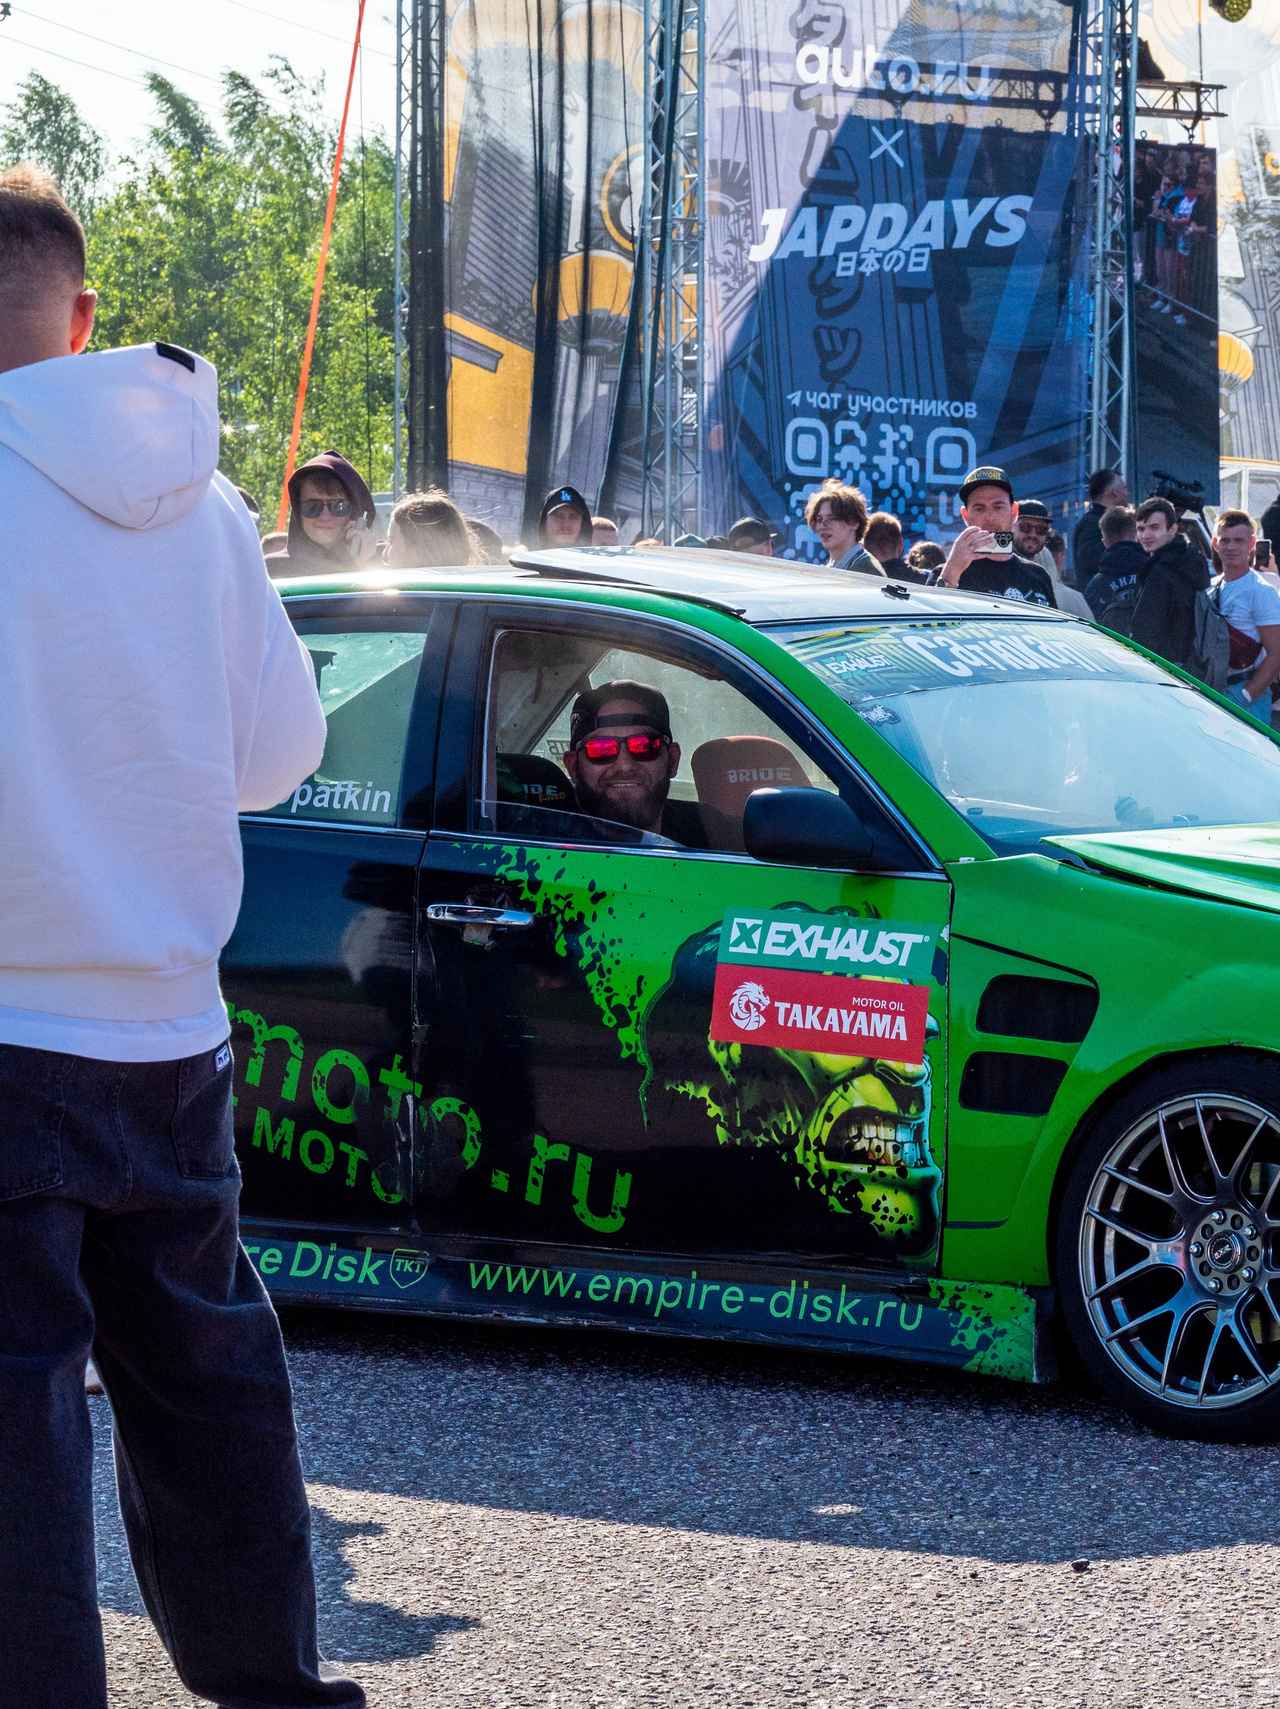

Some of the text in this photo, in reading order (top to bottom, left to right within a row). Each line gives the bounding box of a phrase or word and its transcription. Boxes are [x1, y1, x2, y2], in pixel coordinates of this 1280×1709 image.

[796, 43, 990, 101] auto.ru
[748, 195, 1034, 262] JAPDAYS
[835, 246, 931, 278] 日本の日
[825, 654, 892, 674] EXHAUST
[279, 780, 392, 814] patkin
[763, 921, 925, 967] EXHAUST
[774, 1001, 908, 1041] TAKAYAMA
[852, 996, 906, 1012] MOTOR OIL
[289, 1240, 386, 1286] Disk
[469, 1262, 923, 1331] www.empire-disk.ru
